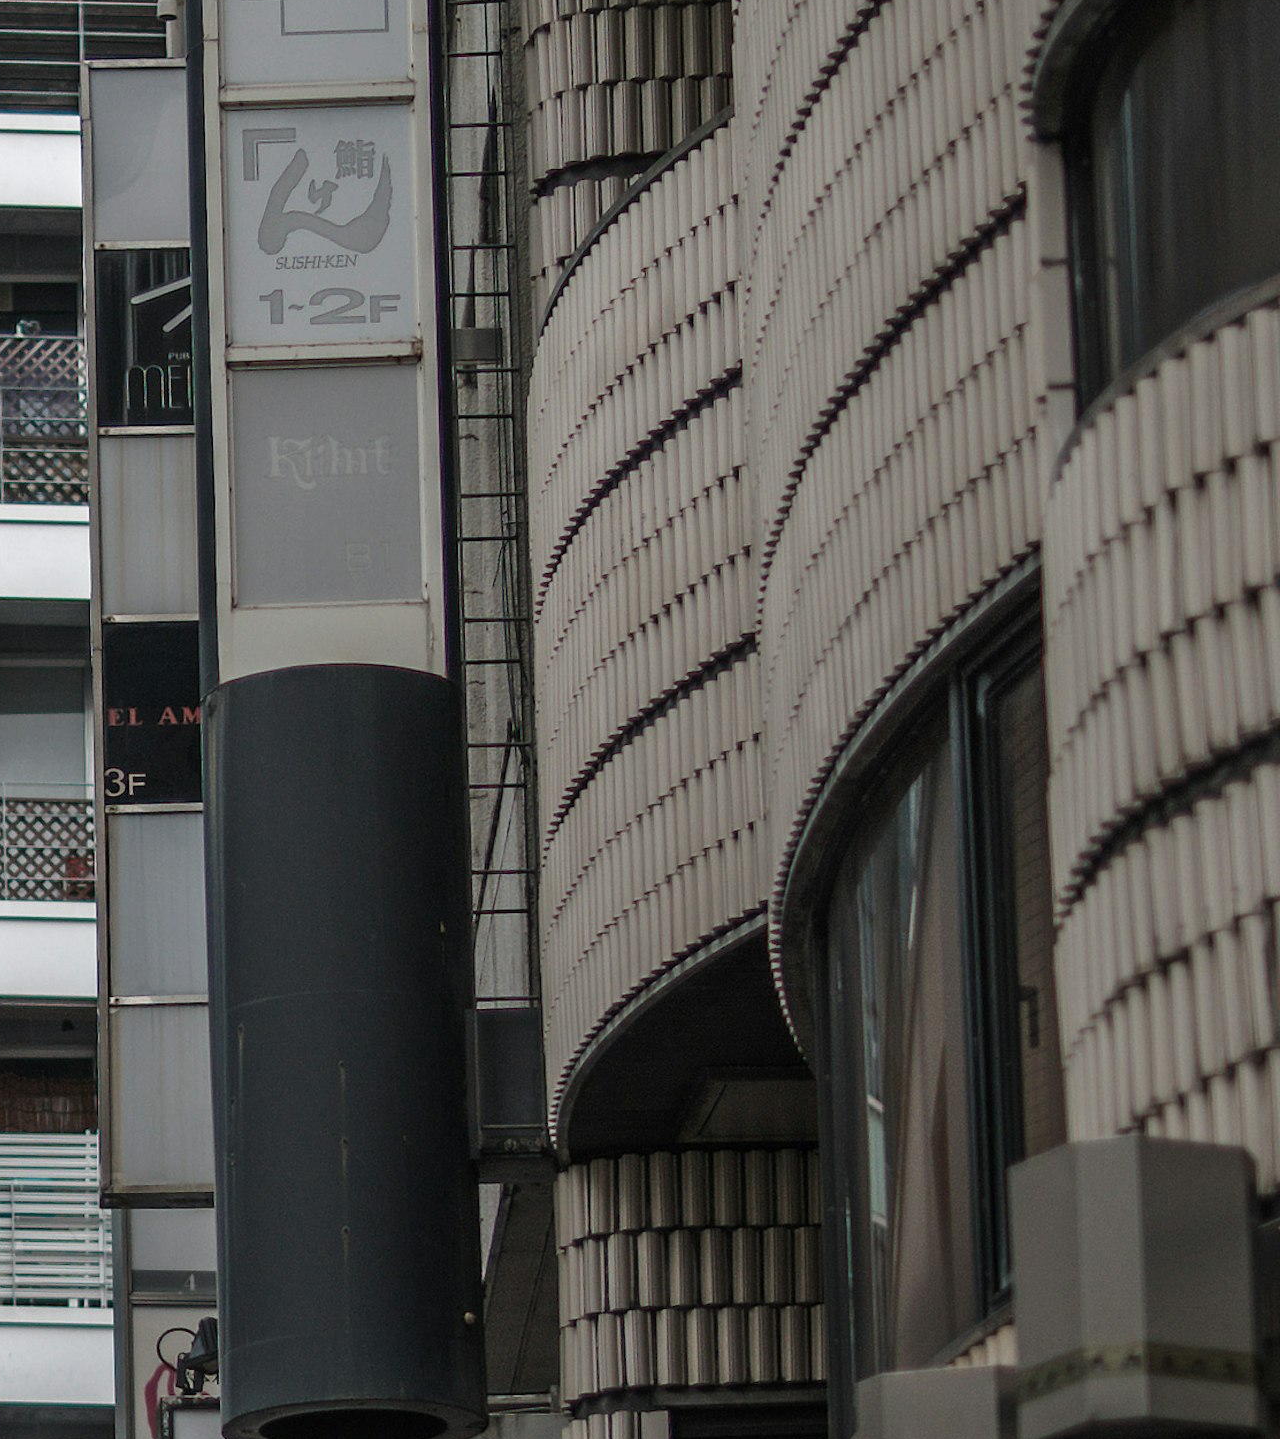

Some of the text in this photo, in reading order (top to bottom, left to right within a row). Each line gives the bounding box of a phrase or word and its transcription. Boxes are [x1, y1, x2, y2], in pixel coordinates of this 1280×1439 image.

[275, 254, 359, 271] SUSHI-KEN
[108, 706, 144, 727] EL
[103, 765, 147, 798] 3F
